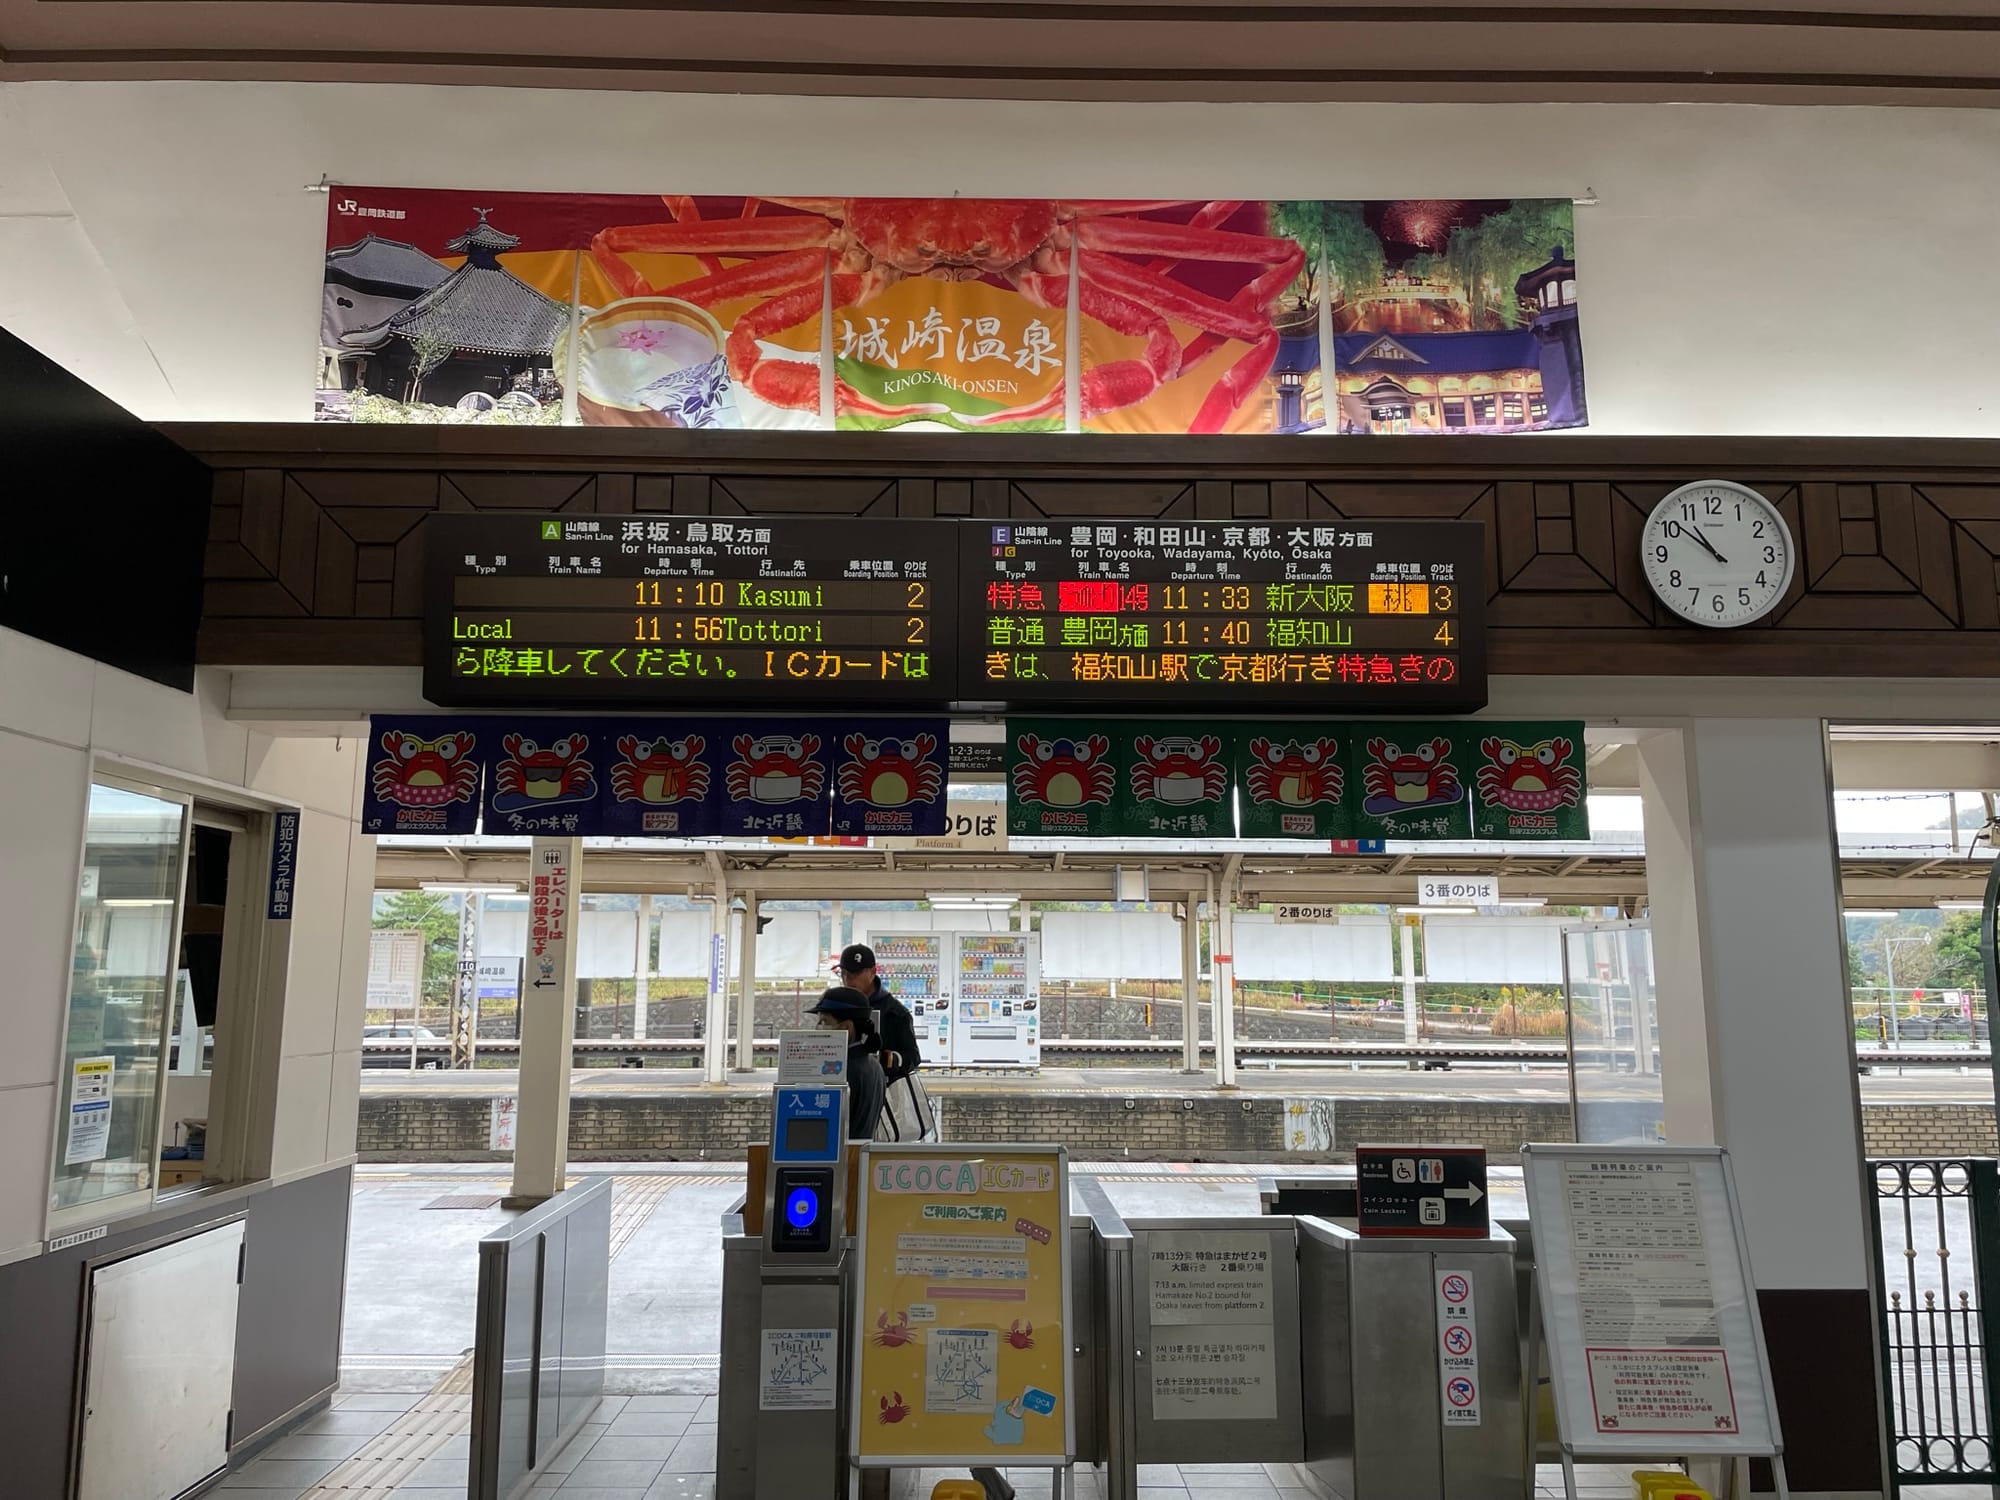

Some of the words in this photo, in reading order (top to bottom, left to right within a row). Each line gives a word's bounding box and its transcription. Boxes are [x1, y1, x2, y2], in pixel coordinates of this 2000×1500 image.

[337, 199, 357, 212] JR
[837, 306, 1063, 376] 城崎温泉
[883, 370, 1019, 395] KINOSAKI-ONSEN
[1680, 503, 1696, 521] 11
[1702, 497, 1722, 515] 12
[1734, 504, 1741, 522] 1
[544, 524, 559, 538] A
[565, 521, 600, 532] 山陰線
[621, 521, 772, 544] 浜坂・鳥取方面
[1014, 526, 1048, 537] 山陰線
[1660, 520, 1681, 539] 10
[1752, 521, 1765, 539] 2
[565, 532, 593, 541] San-in
[595, 533, 614, 541] Line
[996, 528, 1007, 544] E
[1014, 537, 1043, 545] San-in
[1044, 537, 1063, 546] Line
[1070, 526, 1373, 547] 豊岡・和田山・京都・大阪方面
[621, 543, 640, 554] for
[647, 543, 717, 557] Hamasaka,
[725, 544, 768, 556] Tottori
[1071, 547, 1088, 558] for
[1099, 548, 1155, 560] Toyooka,
[1163, 548, 1236, 560] Wadayama,
[1656, 545, 1668, 563] 9
[1763, 546, 1776, 564] 3
[464, 554, 507, 566] 種別
[549, 556, 602, 567] 列車名
[658, 557, 702, 569] 時刻
[761, 559, 806, 570] 行先
[849, 560, 894, 571] 乗車位置
[904, 561, 928, 571] のりば
[995, 561, 1036, 572] 種別
[474, 565, 496, 575] Type
[549, 566, 572, 575] Train
[576, 566, 601, 575] Name
[644, 567, 688, 577] Departure
[692, 568, 714, 577] Time
[759, 569, 807, 578] Destination
[1078, 562, 1130, 572] 列車名
[1185, 562, 1228, 572] 時刻
[1286, 563, 1332, 573] 行先
[1376, 563, 1421, 573] 乗車位置
[1430, 563, 1454, 573] のりば
[843, 571, 872, 580] Boarding
[873, 571, 899, 579] Position
[904, 571, 928, 579] Track
[1005, 571, 1026, 580] Type
[1078, 572, 1101, 580] Train
[1105, 572, 1130, 580] Name
[1171, 572, 1214, 581] Departure
[1219, 572, 1241, 580] Time
[1285, 572, 1333, 581] Destination
[1370, 573, 1399, 582] Boarding
[1400, 573, 1427, 581] Position
[1430, 573, 1454, 581] Track
[1669, 570, 1682, 588] 8
[1755, 570, 1767, 588] 4
[738, 582, 824, 607] Kasumi
[907, 582, 925, 608] 2
[987, 581, 1046, 611] 特急
[1265, 583, 1355, 612] 新大阪
[1382, 585, 1413, 612] 桃
[1434, 585, 1453, 611] 3
[1688, 587, 1701, 606] 7
[1738, 588, 1751, 606] 5
[1712, 595, 1725, 613] 6
[453, 616, 513, 640] Local
[723, 617, 824, 642] Tottori
[907, 617, 925, 643] 2
[987, 616, 1046, 645] 普通
[1266, 618, 1352, 646] 福知山
[1433, 620, 1454, 646] 4
[456, 647, 738, 678] ら降車してください。
[396, 809, 448, 822] かにカニ
[743, 812, 804, 832] 北近畿
[864, 810, 913, 824] かにカニ
[1040, 812, 1088, 825] かにカニ
[1508, 815, 1557, 828] かにカニ
[367, 818, 382, 828] JR
[507, 813, 579, 832] 冬の味覚
[836, 820, 850, 830] JR
[1012, 820, 1027, 831] JR
[1149, 815, 1209, 833] 北近畿
[1380, 816, 1451, 836] 冬の味覚
[1480, 823, 1494, 834] JR
[915, 839, 956, 848] Platform
[273, 815, 296, 917] 防犯カメラ作動中
[1425, 883, 1491, 898] 3番のりば
[549, 867, 567, 940] エレベーターは
[532, 876, 550, 956] 階段の後ろ側です
[1279, 906, 1334, 918] 2番のりば
[788, 1093, 831, 1109] 入場
[878, 1164, 977, 1192] ICOCA
[923, 1205, 1008, 1222] ご利用のご案内
[1171, 1263, 1207, 1273] 大阪行き
[1189, 1281, 1215, 1289] limited
[1216, 1282, 1244, 1291] express
[1246, 1281, 1264, 1289] train
[1155, 1291, 1194, 1300] Hamakaze
[1214, 1291, 1240, 1300] bound
[1240, 1291, 1253, 1299] for
[1155, 1302, 1178, 1310] Osaka
[1179, 1301, 1204, 1310] leaves
[1205, 1301, 1223, 1310] from
[1224, 1301, 1258, 1312] platform
